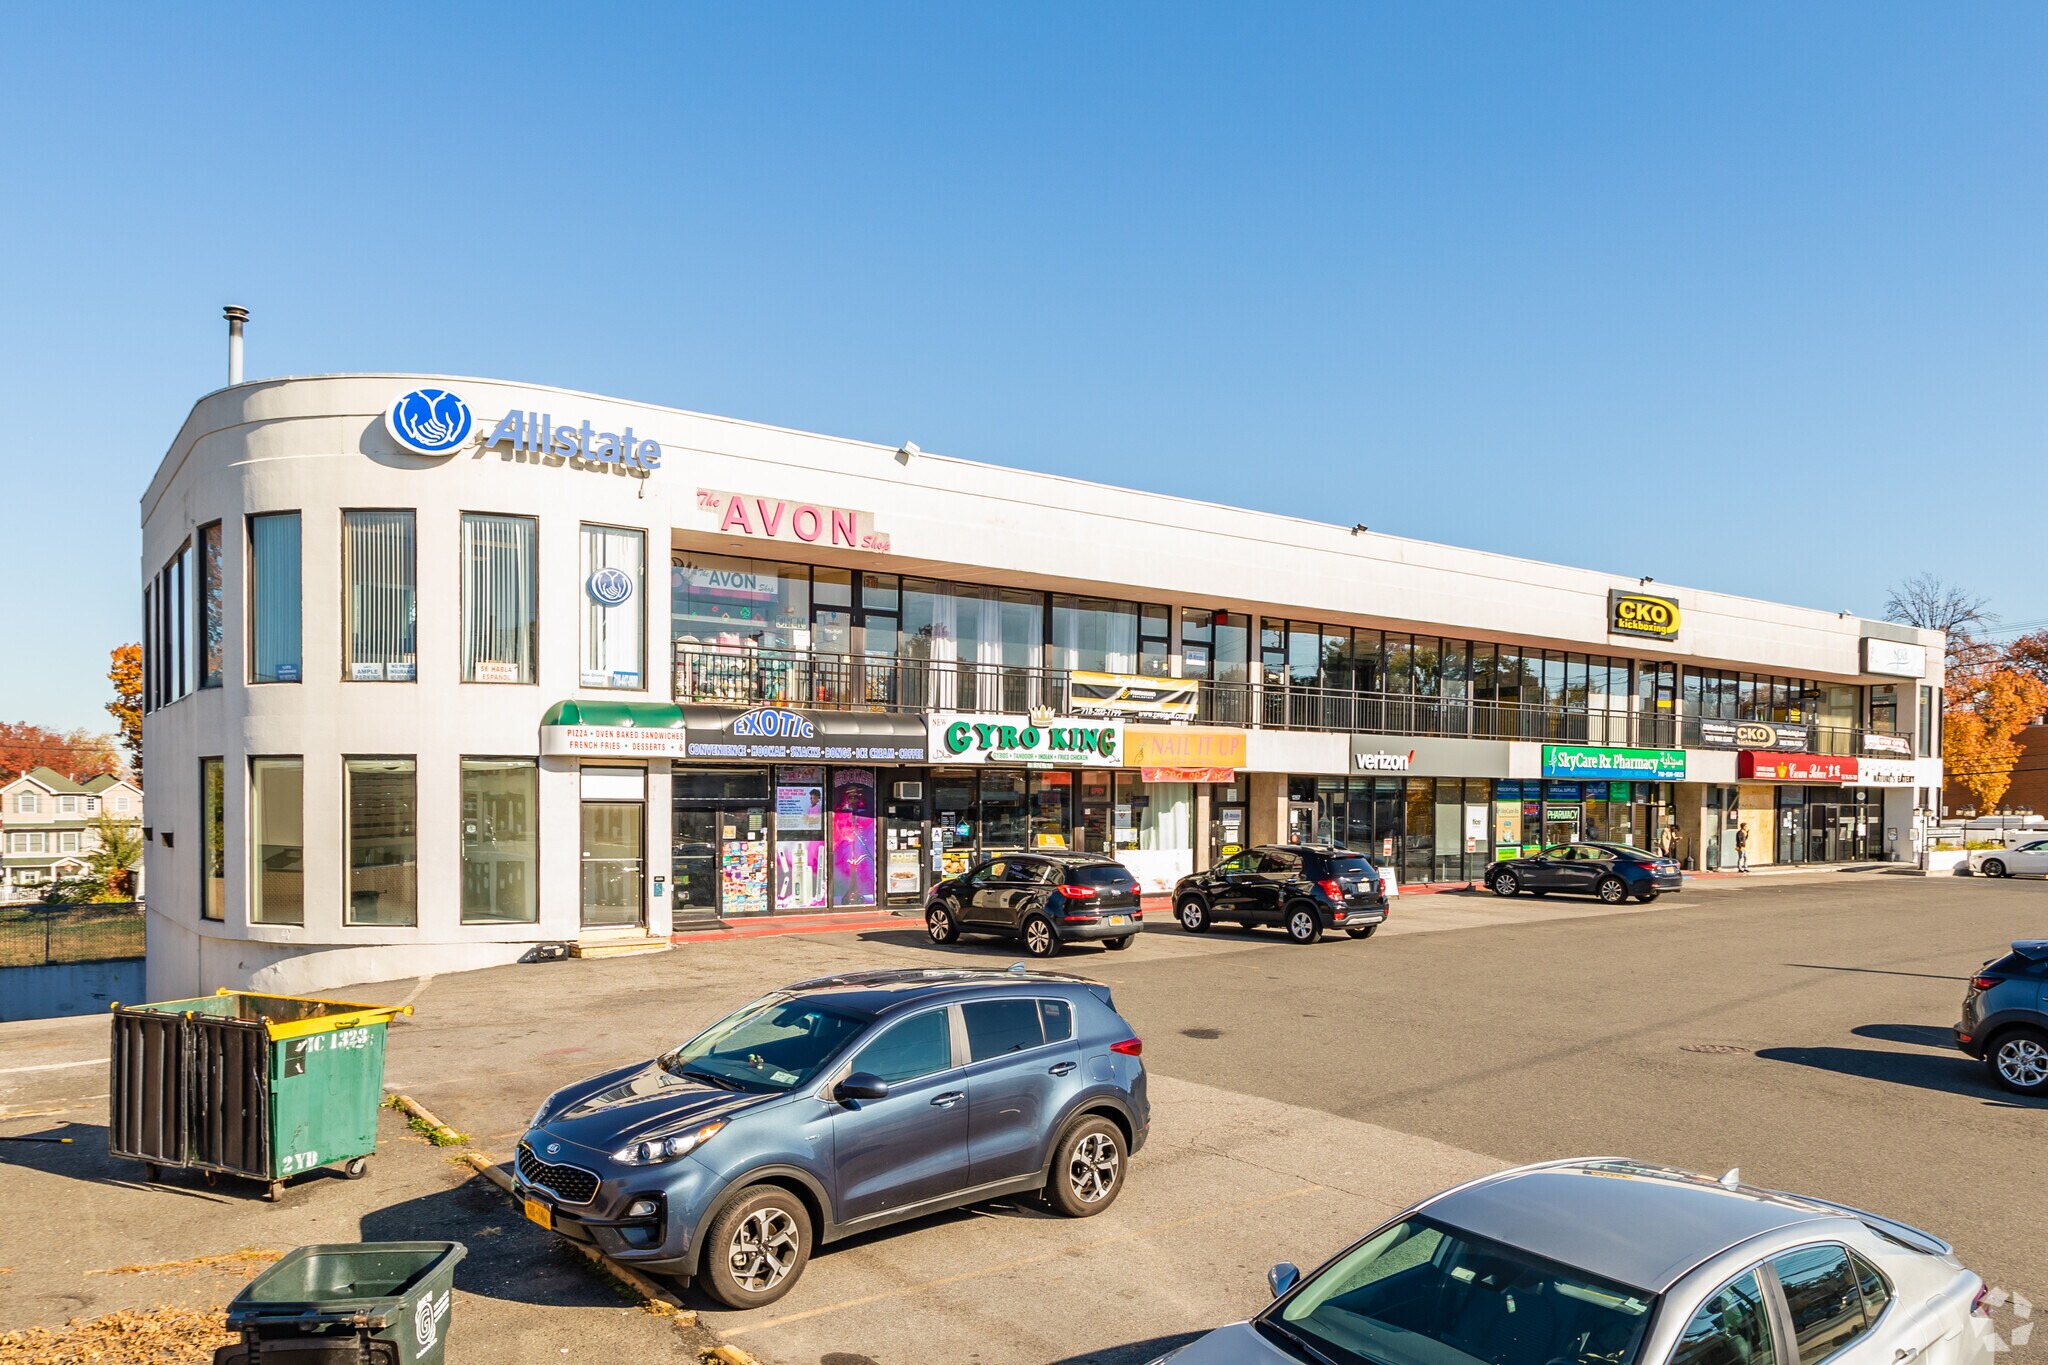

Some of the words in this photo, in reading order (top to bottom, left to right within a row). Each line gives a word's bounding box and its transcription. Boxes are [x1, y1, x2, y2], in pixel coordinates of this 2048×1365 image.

[486, 409, 662, 470] Allstate
[697, 490, 720, 509] The
[721, 495, 859, 548] AVON
[861, 534, 892, 553] Shop
[708, 571, 756, 591] AVON
[758, 583, 775, 594] Shop
[1619, 600, 1668, 623] CKO
[1618, 618, 1668, 636] kickboxing
[480, 665, 489, 673] SE
[491, 666, 513, 674] HABLA
[734, 710, 814, 738] EXOTIC
[932, 719, 946, 727] NEW
[567, 729, 588, 738] PIZZA
[595, 730, 614, 739] OVEN
[616, 731, 639, 740] BAKED
[641, 731, 684, 741] SANDWICHES
[947, 721, 1041, 753] GYRO
[1050, 727, 1116, 756] KING
[1737, 727, 1767, 740] CKO
[569, 741, 598, 750] FRENCH
[600, 742, 620, 751] FRIES
[632, 742, 666, 751] DESSERTS
[688, 743, 747, 756] CONVENIENCE
[750, 745, 786, 758] HOOKAH
[790, 746, 821, 758] SNACKS
[824, 747, 852, 759] BONGS
[856, 748, 868, 759] ICE
[869, 748, 895, 760] CREAM
[899, 748, 924, 760] COFFEE
[1152, 735, 1190, 756] NAIL
[1197, 736, 1213, 756] IT
[1219, 736, 1240, 756] UP
[1356, 750, 1409, 770] verizon
[1557, 752, 1597, 771] SkyCare
[1599, 753, 1612, 767] Rx
[1613, 754, 1658, 773] Pharmacy
[1547, 808, 1578, 820] PHARMACY
[933, 829, 940, 837] A
[889, 852, 917, 864] FREE
[282, 1156, 293, 1172] 2
[294, 1151, 319, 1170] YD
